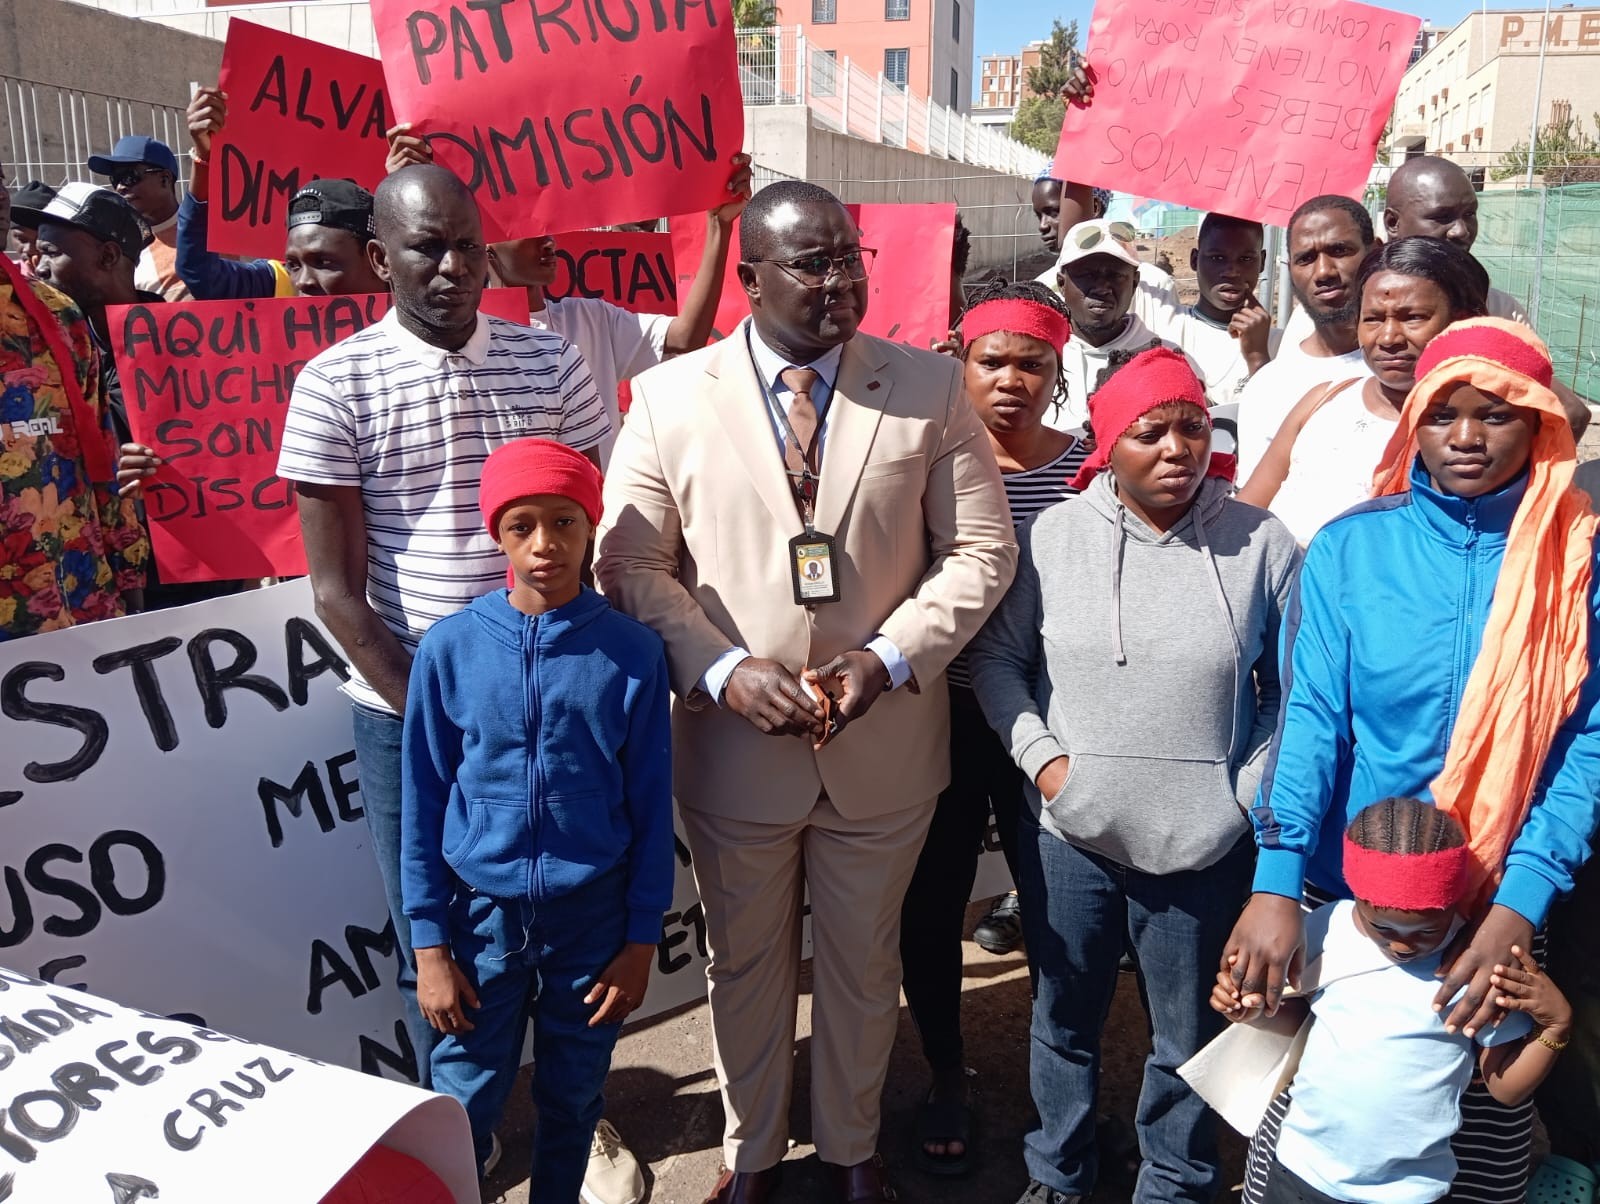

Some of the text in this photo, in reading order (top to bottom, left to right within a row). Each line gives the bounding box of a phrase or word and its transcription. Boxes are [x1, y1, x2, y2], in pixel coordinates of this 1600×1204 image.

[1273, 7, 1370, 39] COMIDA
[1226, 85, 1370, 151] BEBÉS
[155, 418, 274, 464] SON
[146, 476, 297, 522] DISC
[163, 1056, 295, 1152] CRUZ
